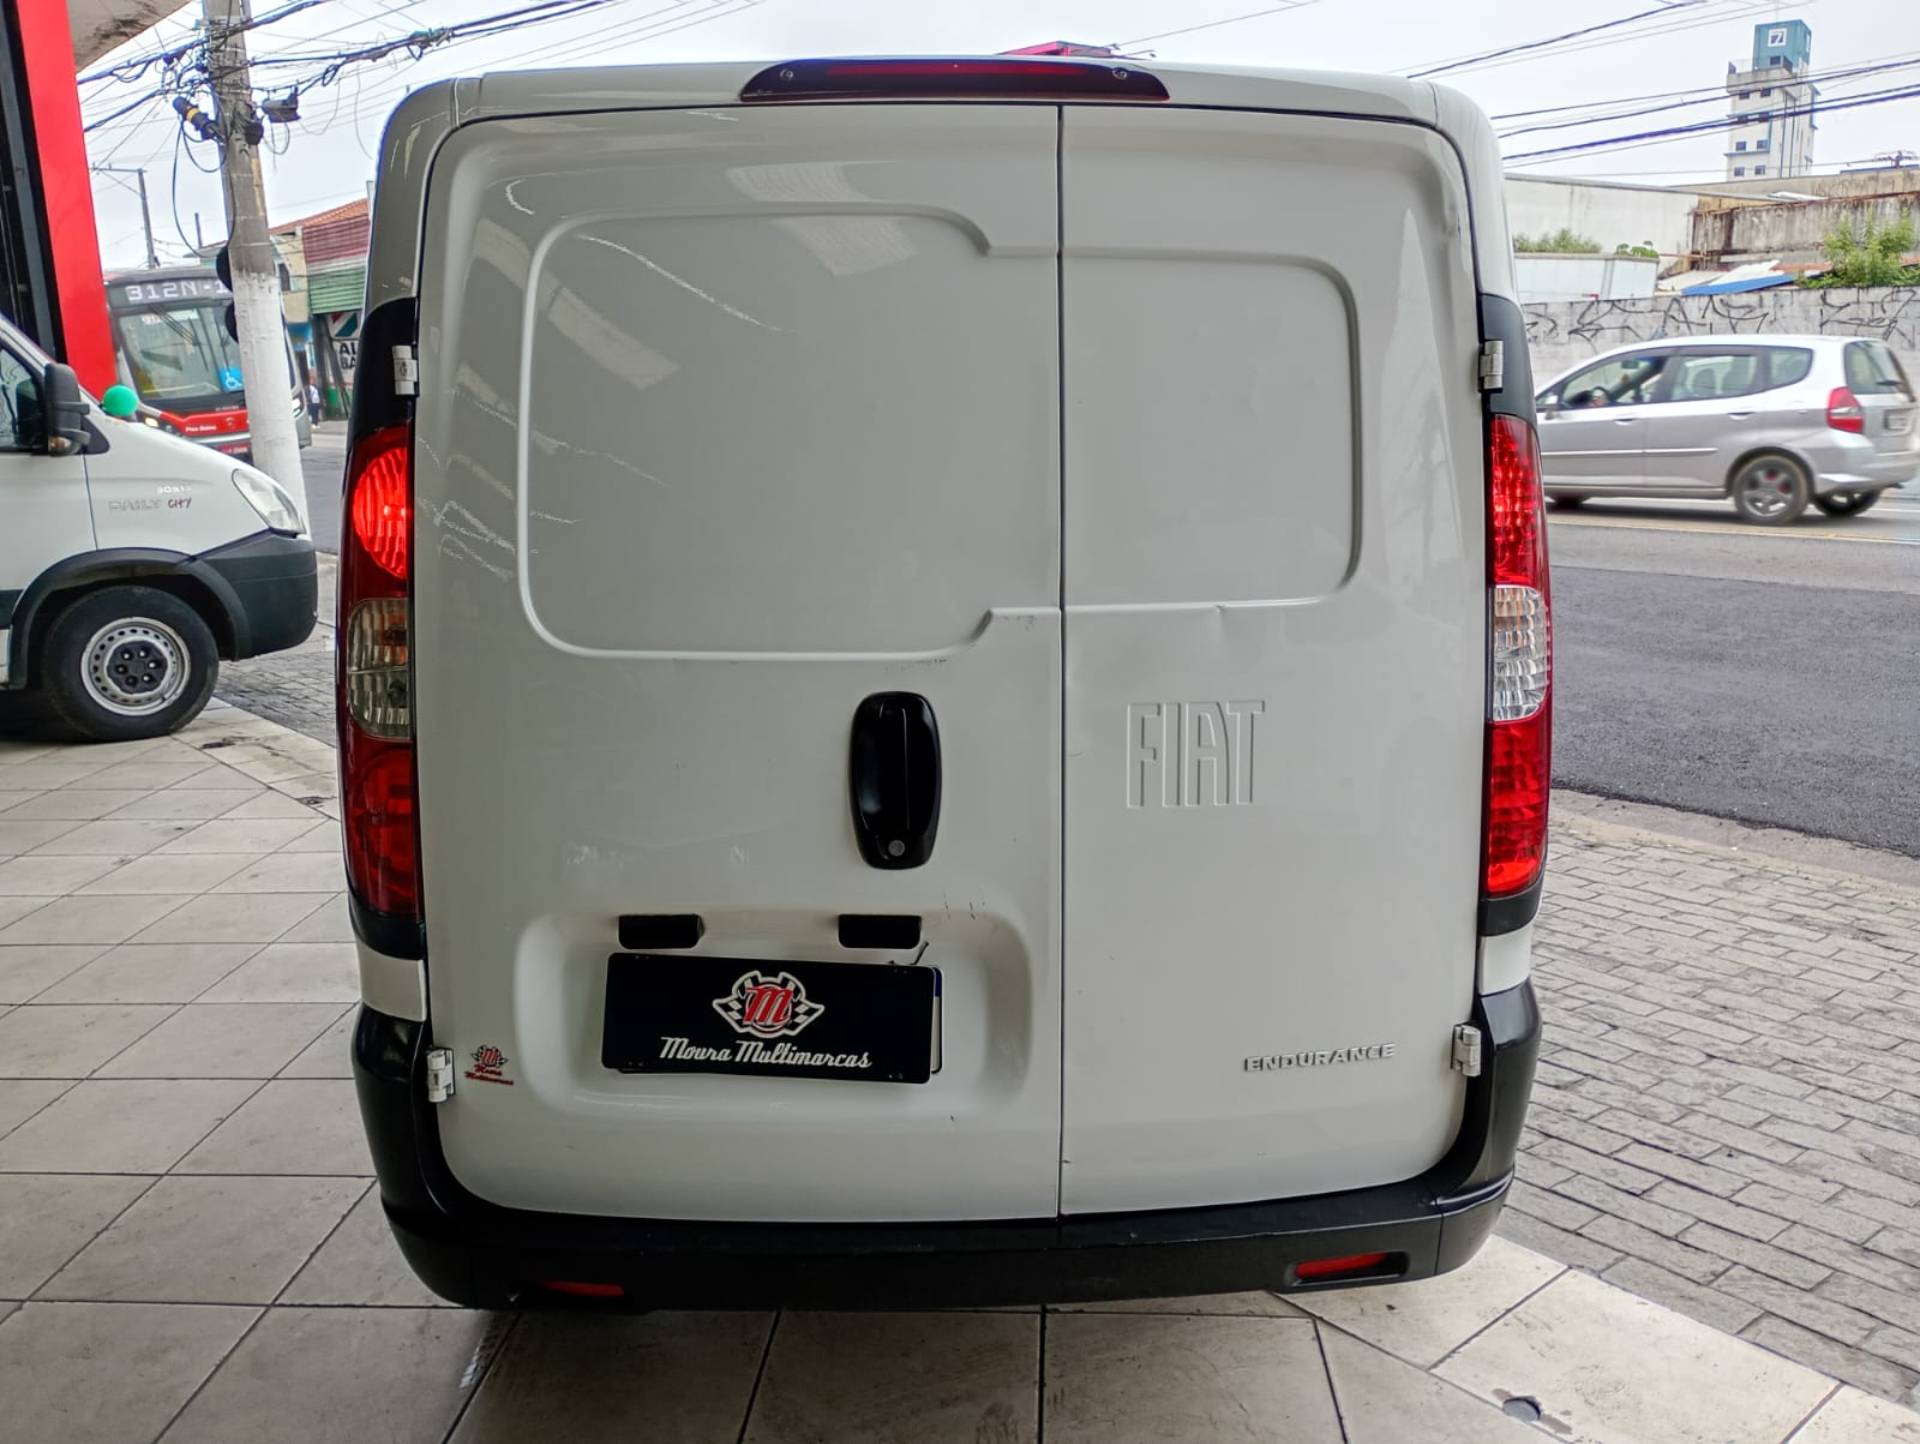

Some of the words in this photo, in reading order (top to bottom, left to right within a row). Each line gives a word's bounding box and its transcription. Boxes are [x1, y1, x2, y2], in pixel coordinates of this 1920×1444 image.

[1126, 700, 1266, 809] FIAT
[659, 1037, 733, 1062] Moura
[734, 1040, 872, 1068] Multimarcas
[1243, 1042, 1397, 1072] ENDURANCE
